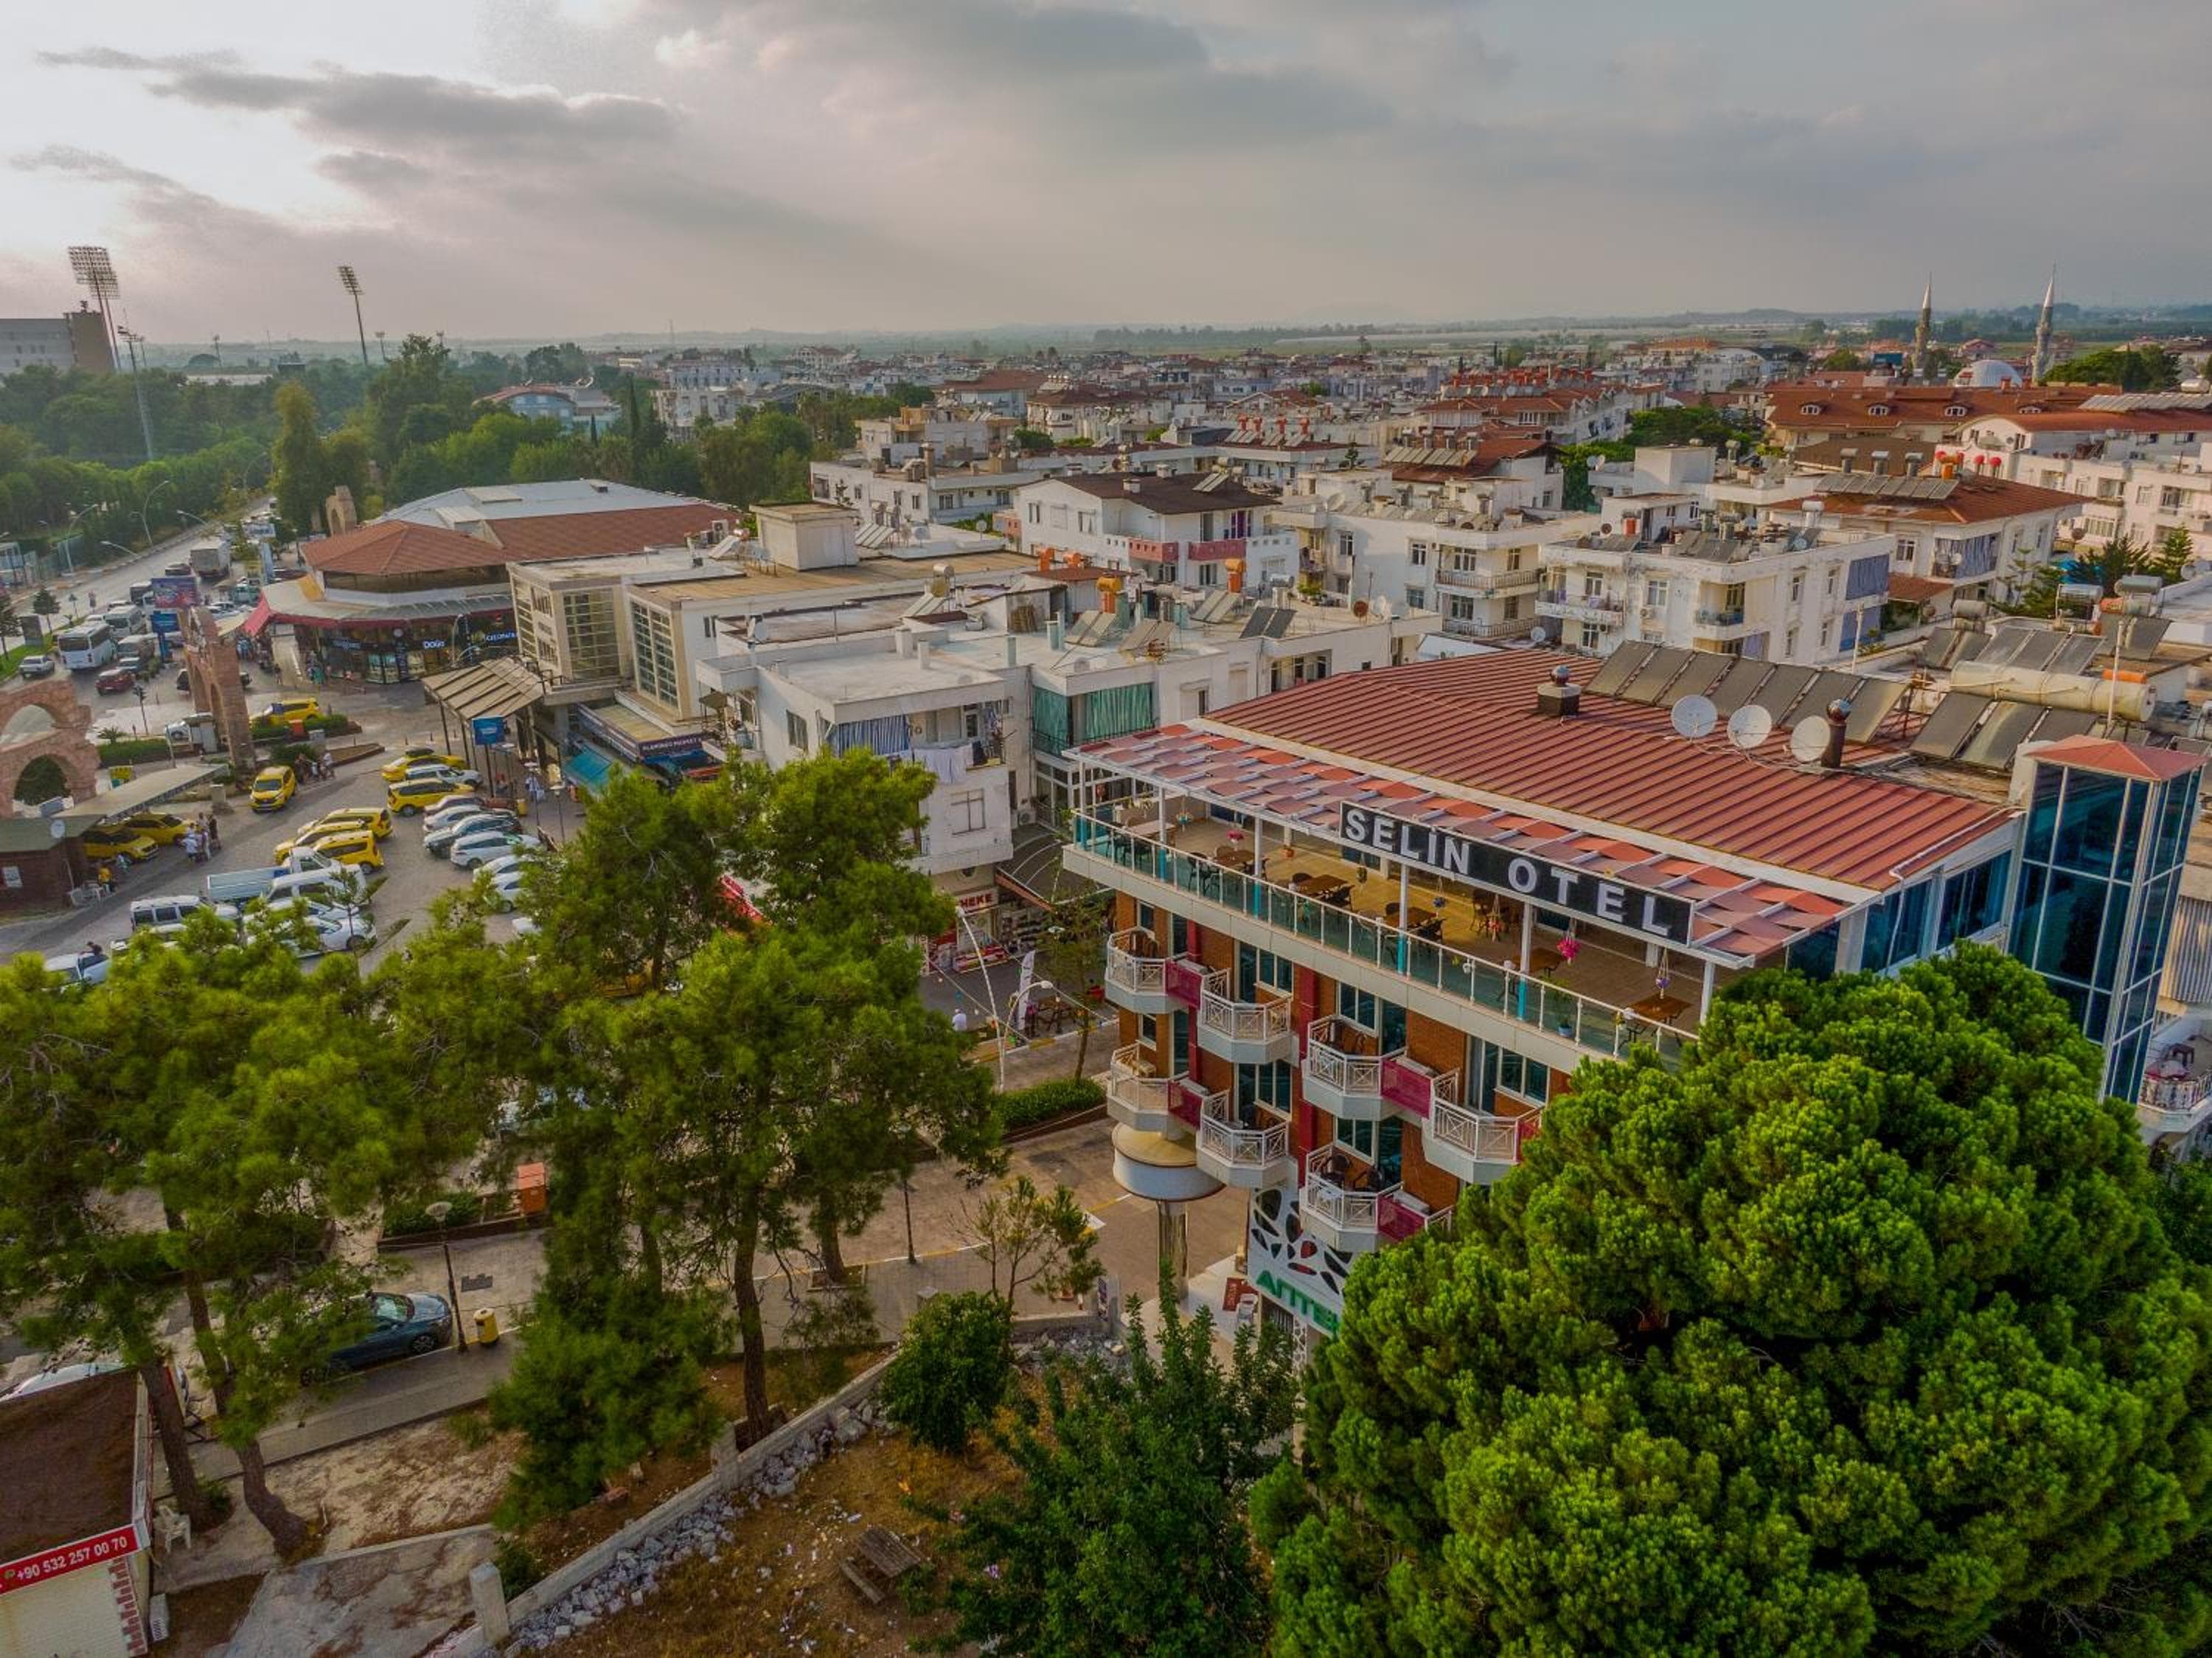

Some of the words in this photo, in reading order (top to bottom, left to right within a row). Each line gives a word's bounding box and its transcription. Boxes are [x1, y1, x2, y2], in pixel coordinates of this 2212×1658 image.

[1508, 858, 1672, 937] OTEL
[17, 1565, 41, 1581] +90
[43, 1555, 67, 1573] 532
[69, 1546, 91, 1564] 257
[94, 1541, 110, 1556] 00
[111, 1536, 128, 1550] 70
